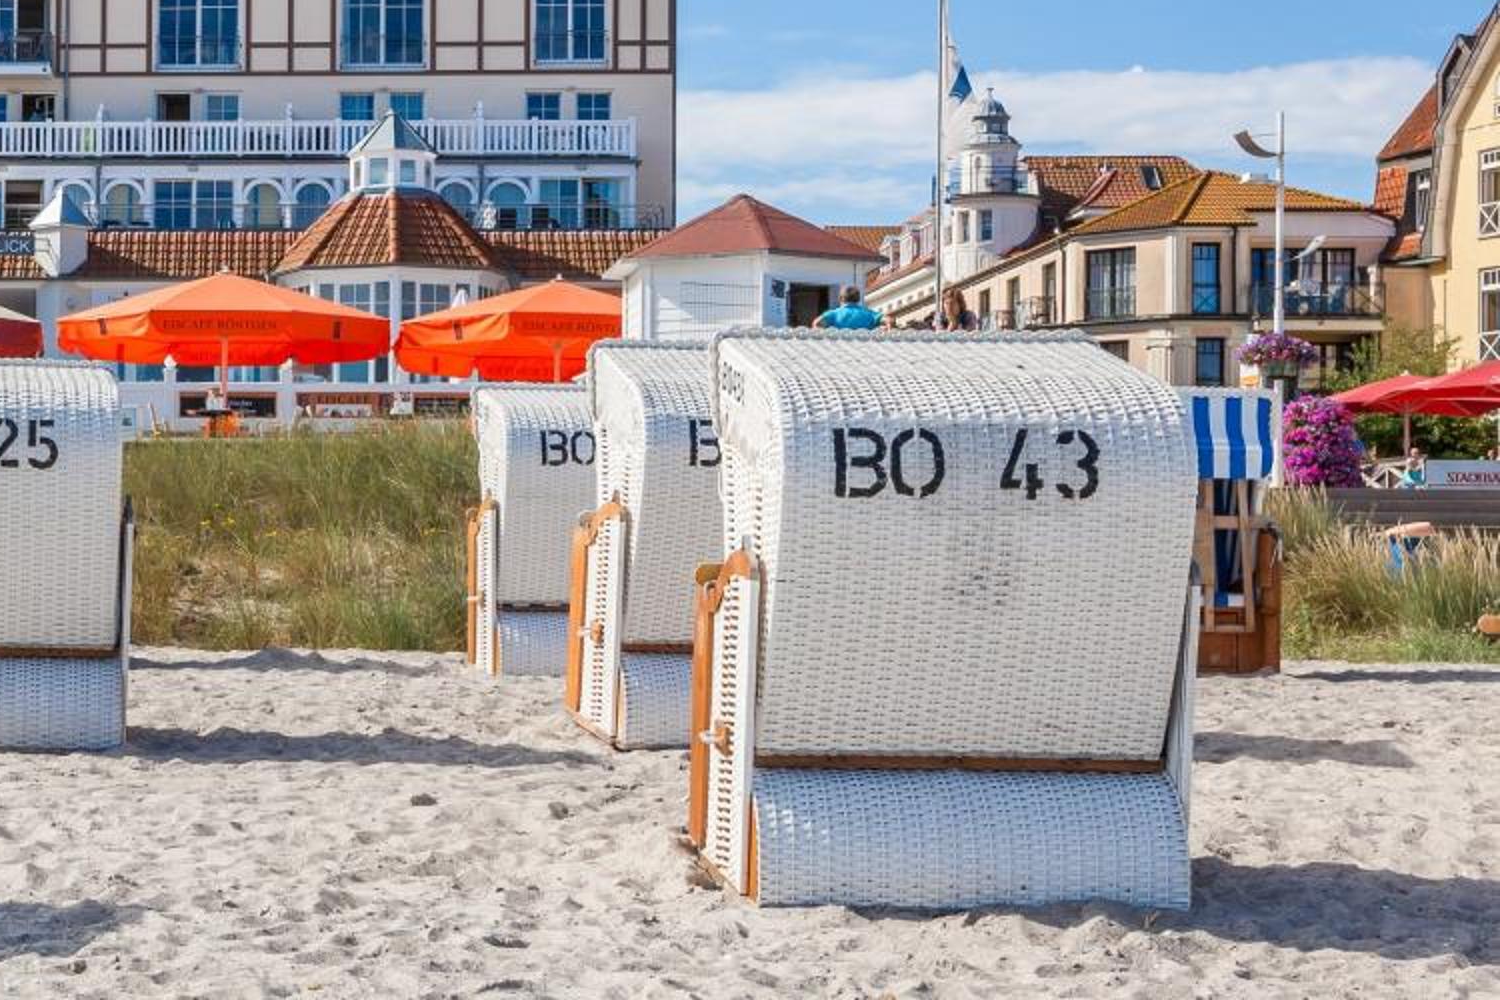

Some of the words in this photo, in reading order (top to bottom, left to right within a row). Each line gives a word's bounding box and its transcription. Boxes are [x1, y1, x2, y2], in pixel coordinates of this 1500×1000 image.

[540, 429, 596, 467] BO
[833, 427, 945, 498] BO
[1000, 428, 1100, 500] 43
